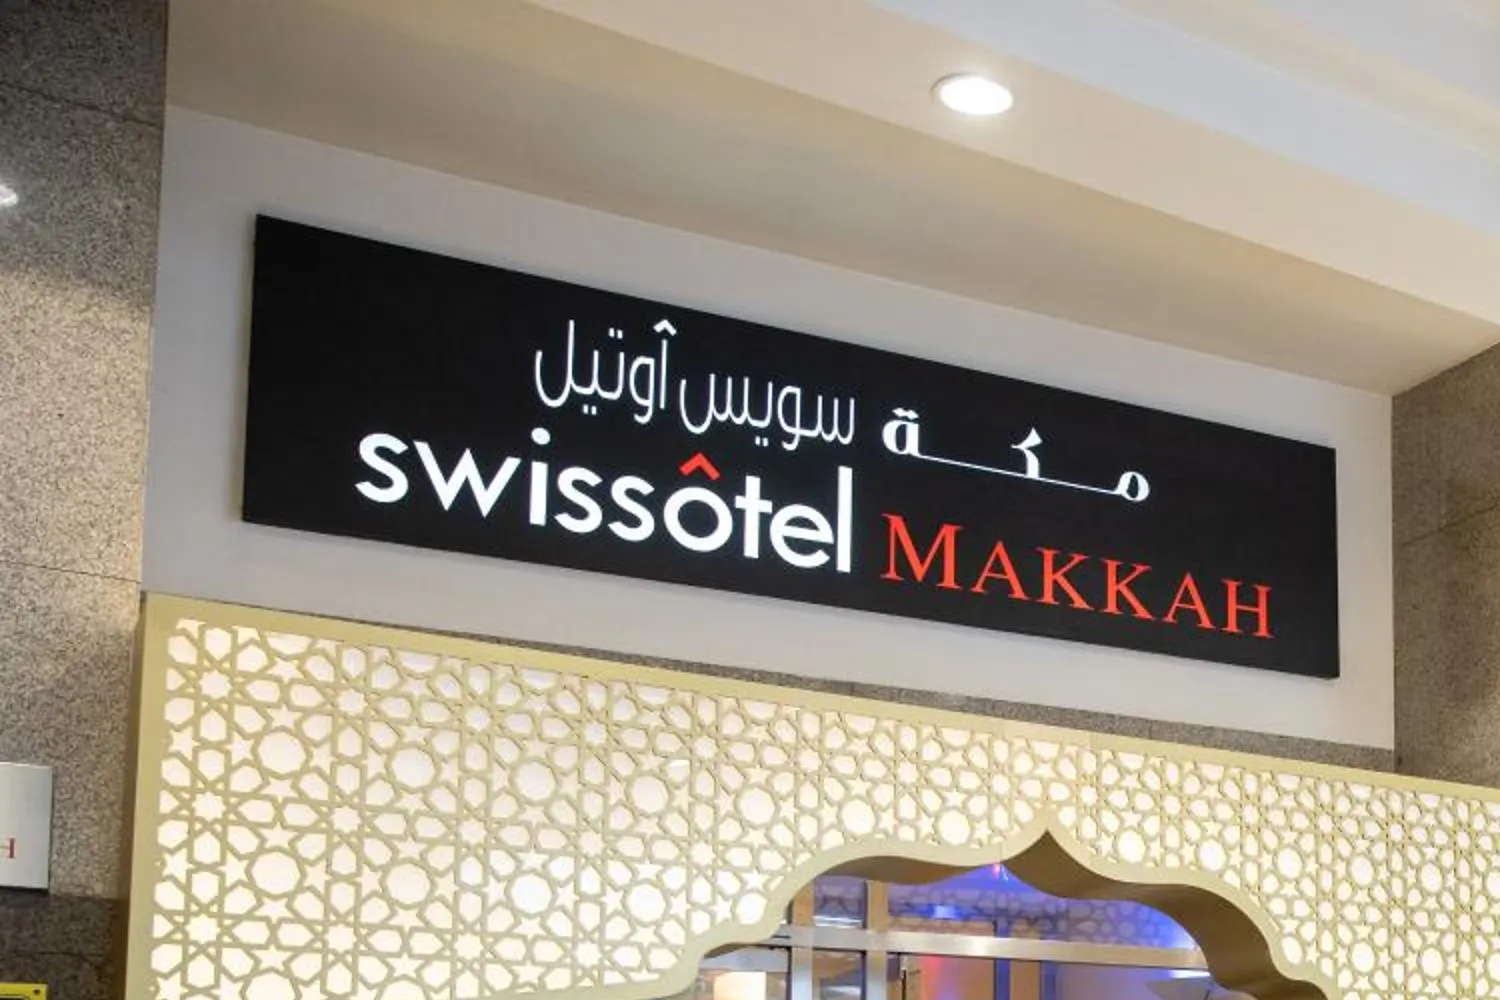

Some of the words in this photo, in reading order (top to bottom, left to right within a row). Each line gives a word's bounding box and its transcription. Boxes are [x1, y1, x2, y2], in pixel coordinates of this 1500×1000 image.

[679, 373, 855, 451] سويس
[882, 407, 1150, 502] مكة
[355, 427, 853, 574] swissôtel
[880, 513, 1274, 639] MAKKAH
